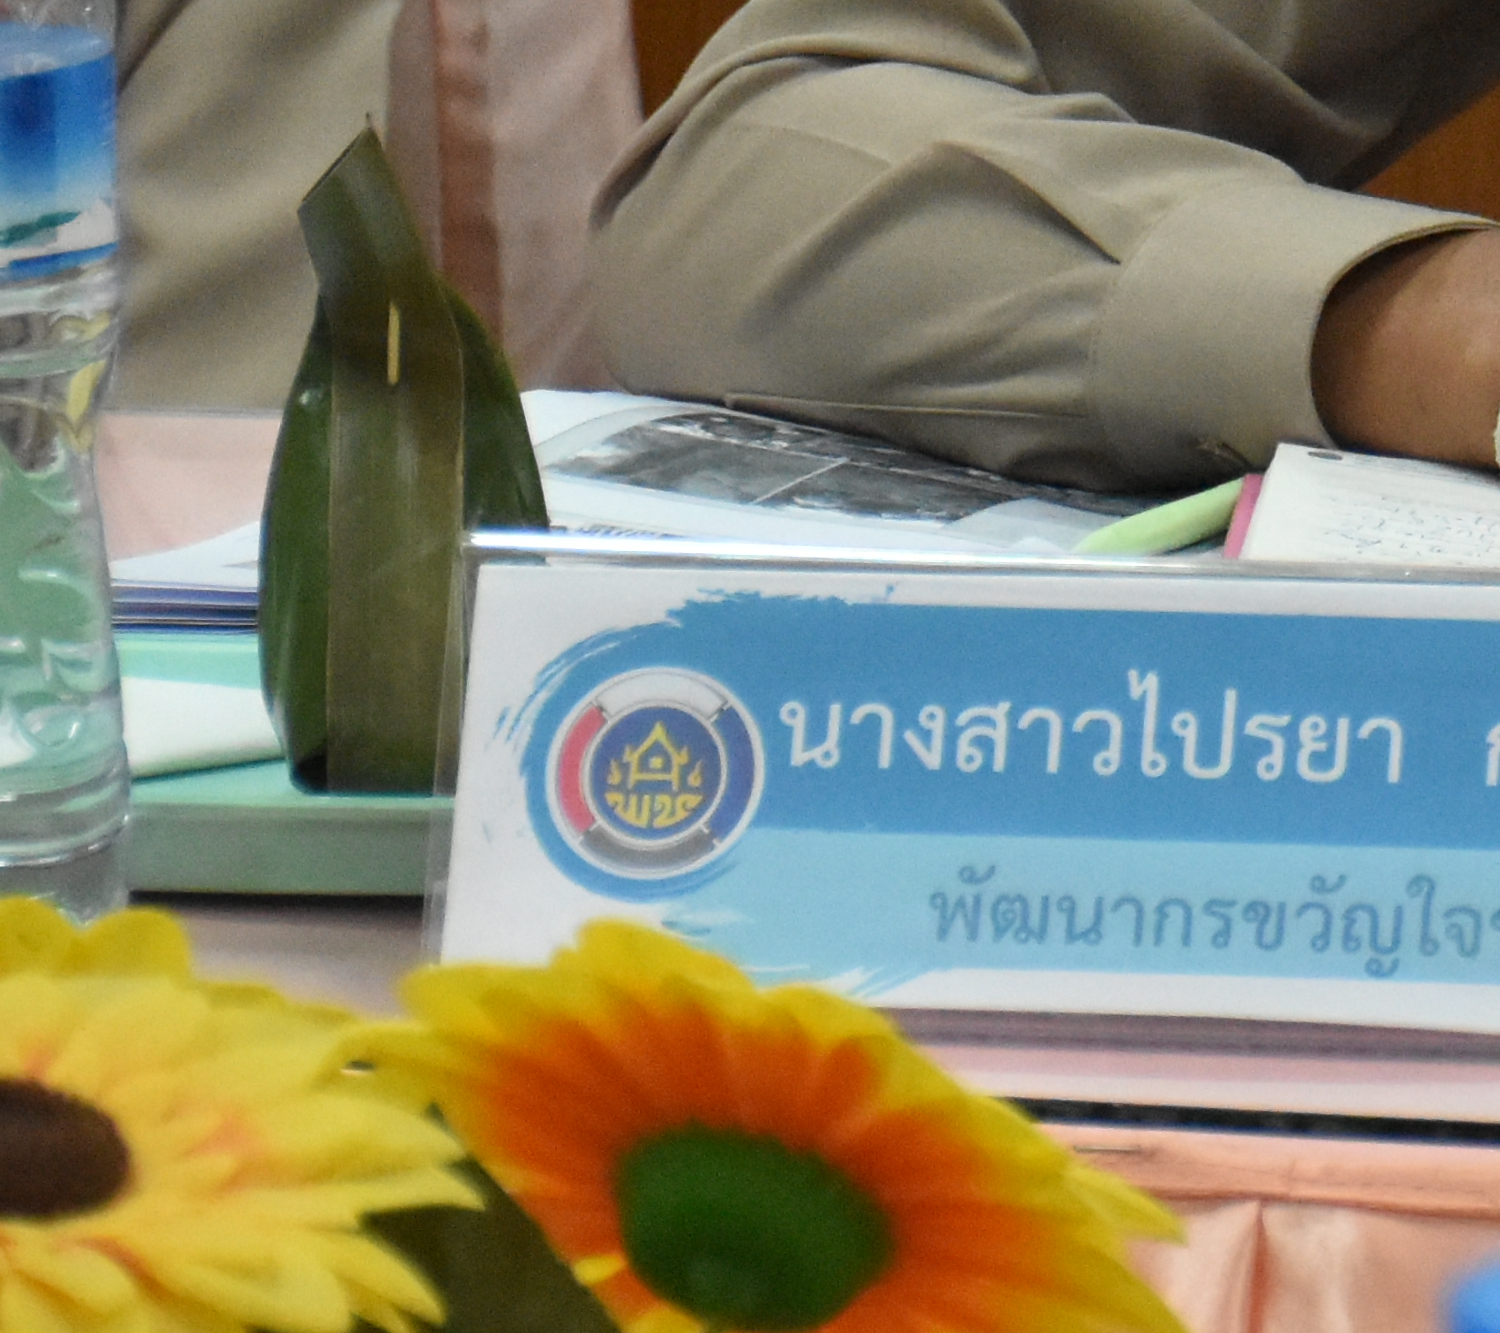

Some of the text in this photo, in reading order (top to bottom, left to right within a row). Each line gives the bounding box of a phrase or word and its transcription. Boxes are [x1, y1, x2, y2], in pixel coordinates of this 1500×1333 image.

[778, 668, 1403, 784] นางสาวไปรยา
